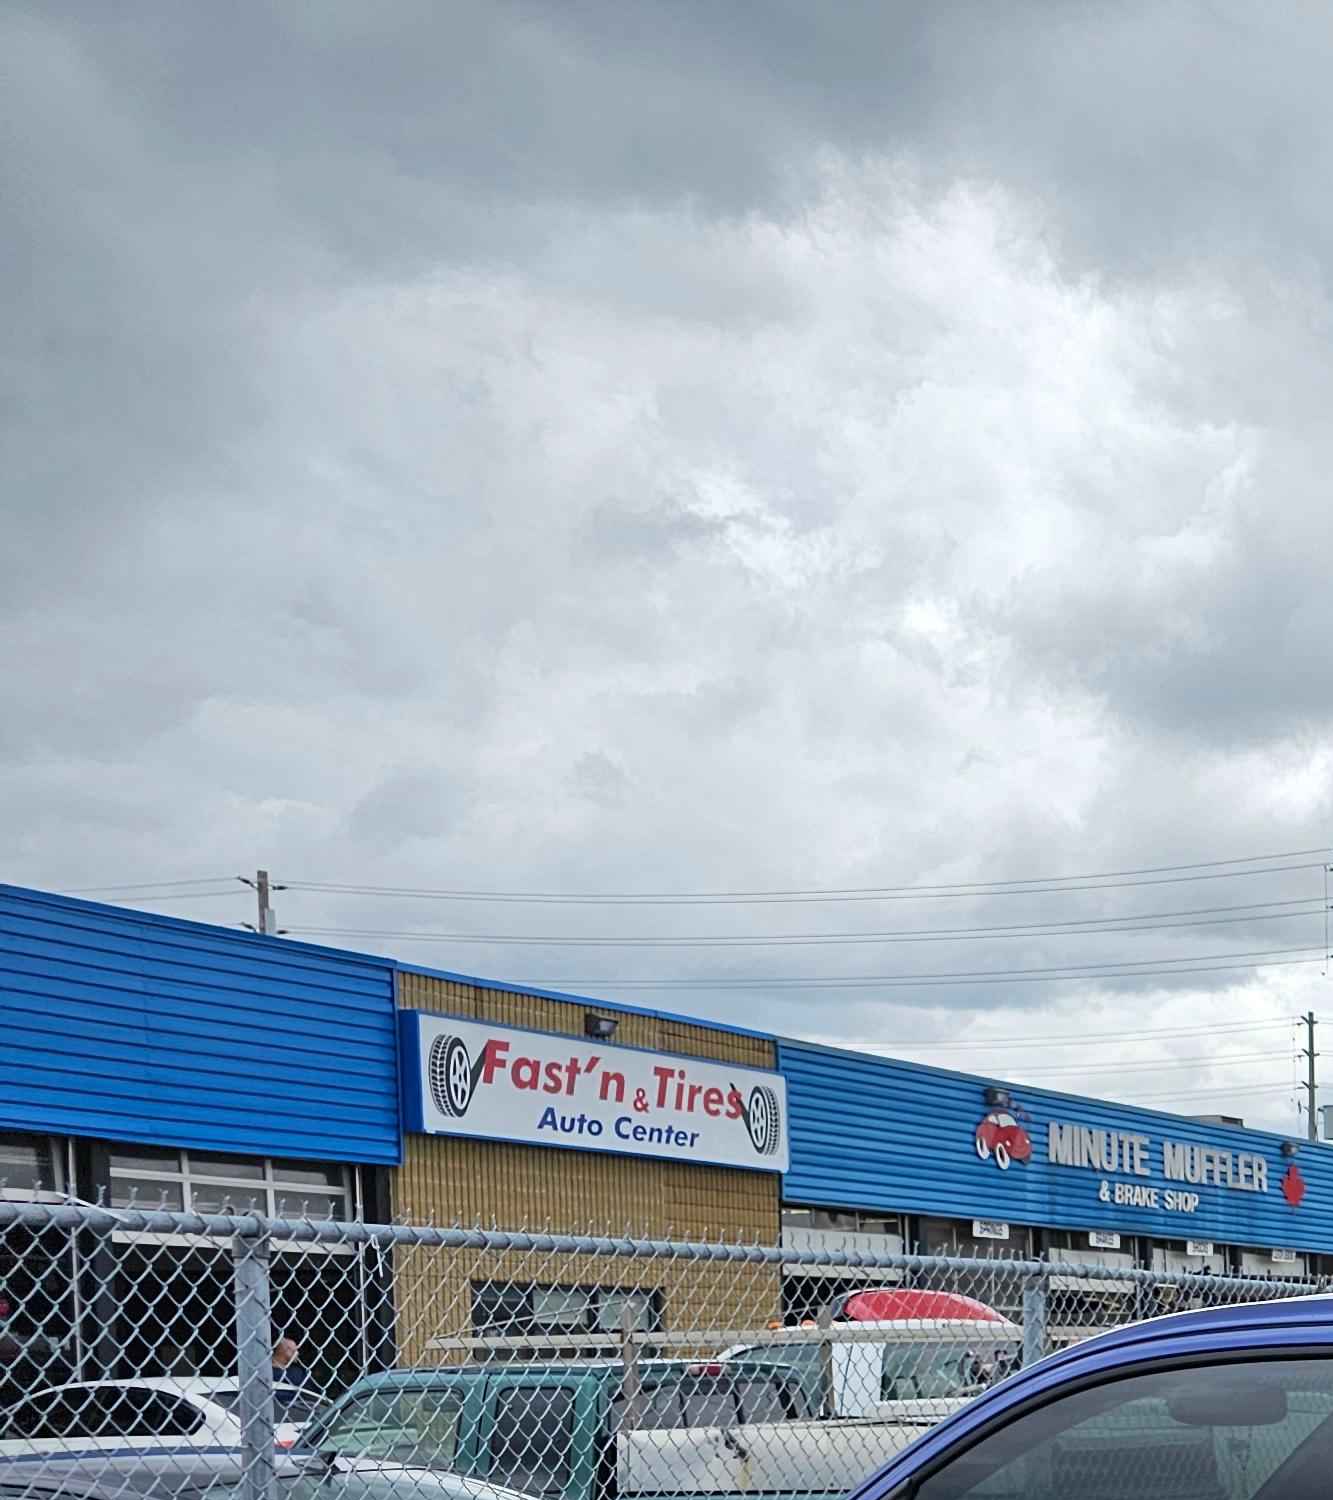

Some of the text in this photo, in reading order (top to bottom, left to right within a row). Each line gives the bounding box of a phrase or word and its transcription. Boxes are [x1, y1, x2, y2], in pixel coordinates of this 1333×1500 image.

[482, 1039, 743, 1120] Fast'n & Tires
[537, 1107, 700, 1149] Auto Center
[1048, 1121, 1269, 1193] MINUTE MUFFLER
[1099, 1181, 1199, 1213] & BRAKE SHOP
